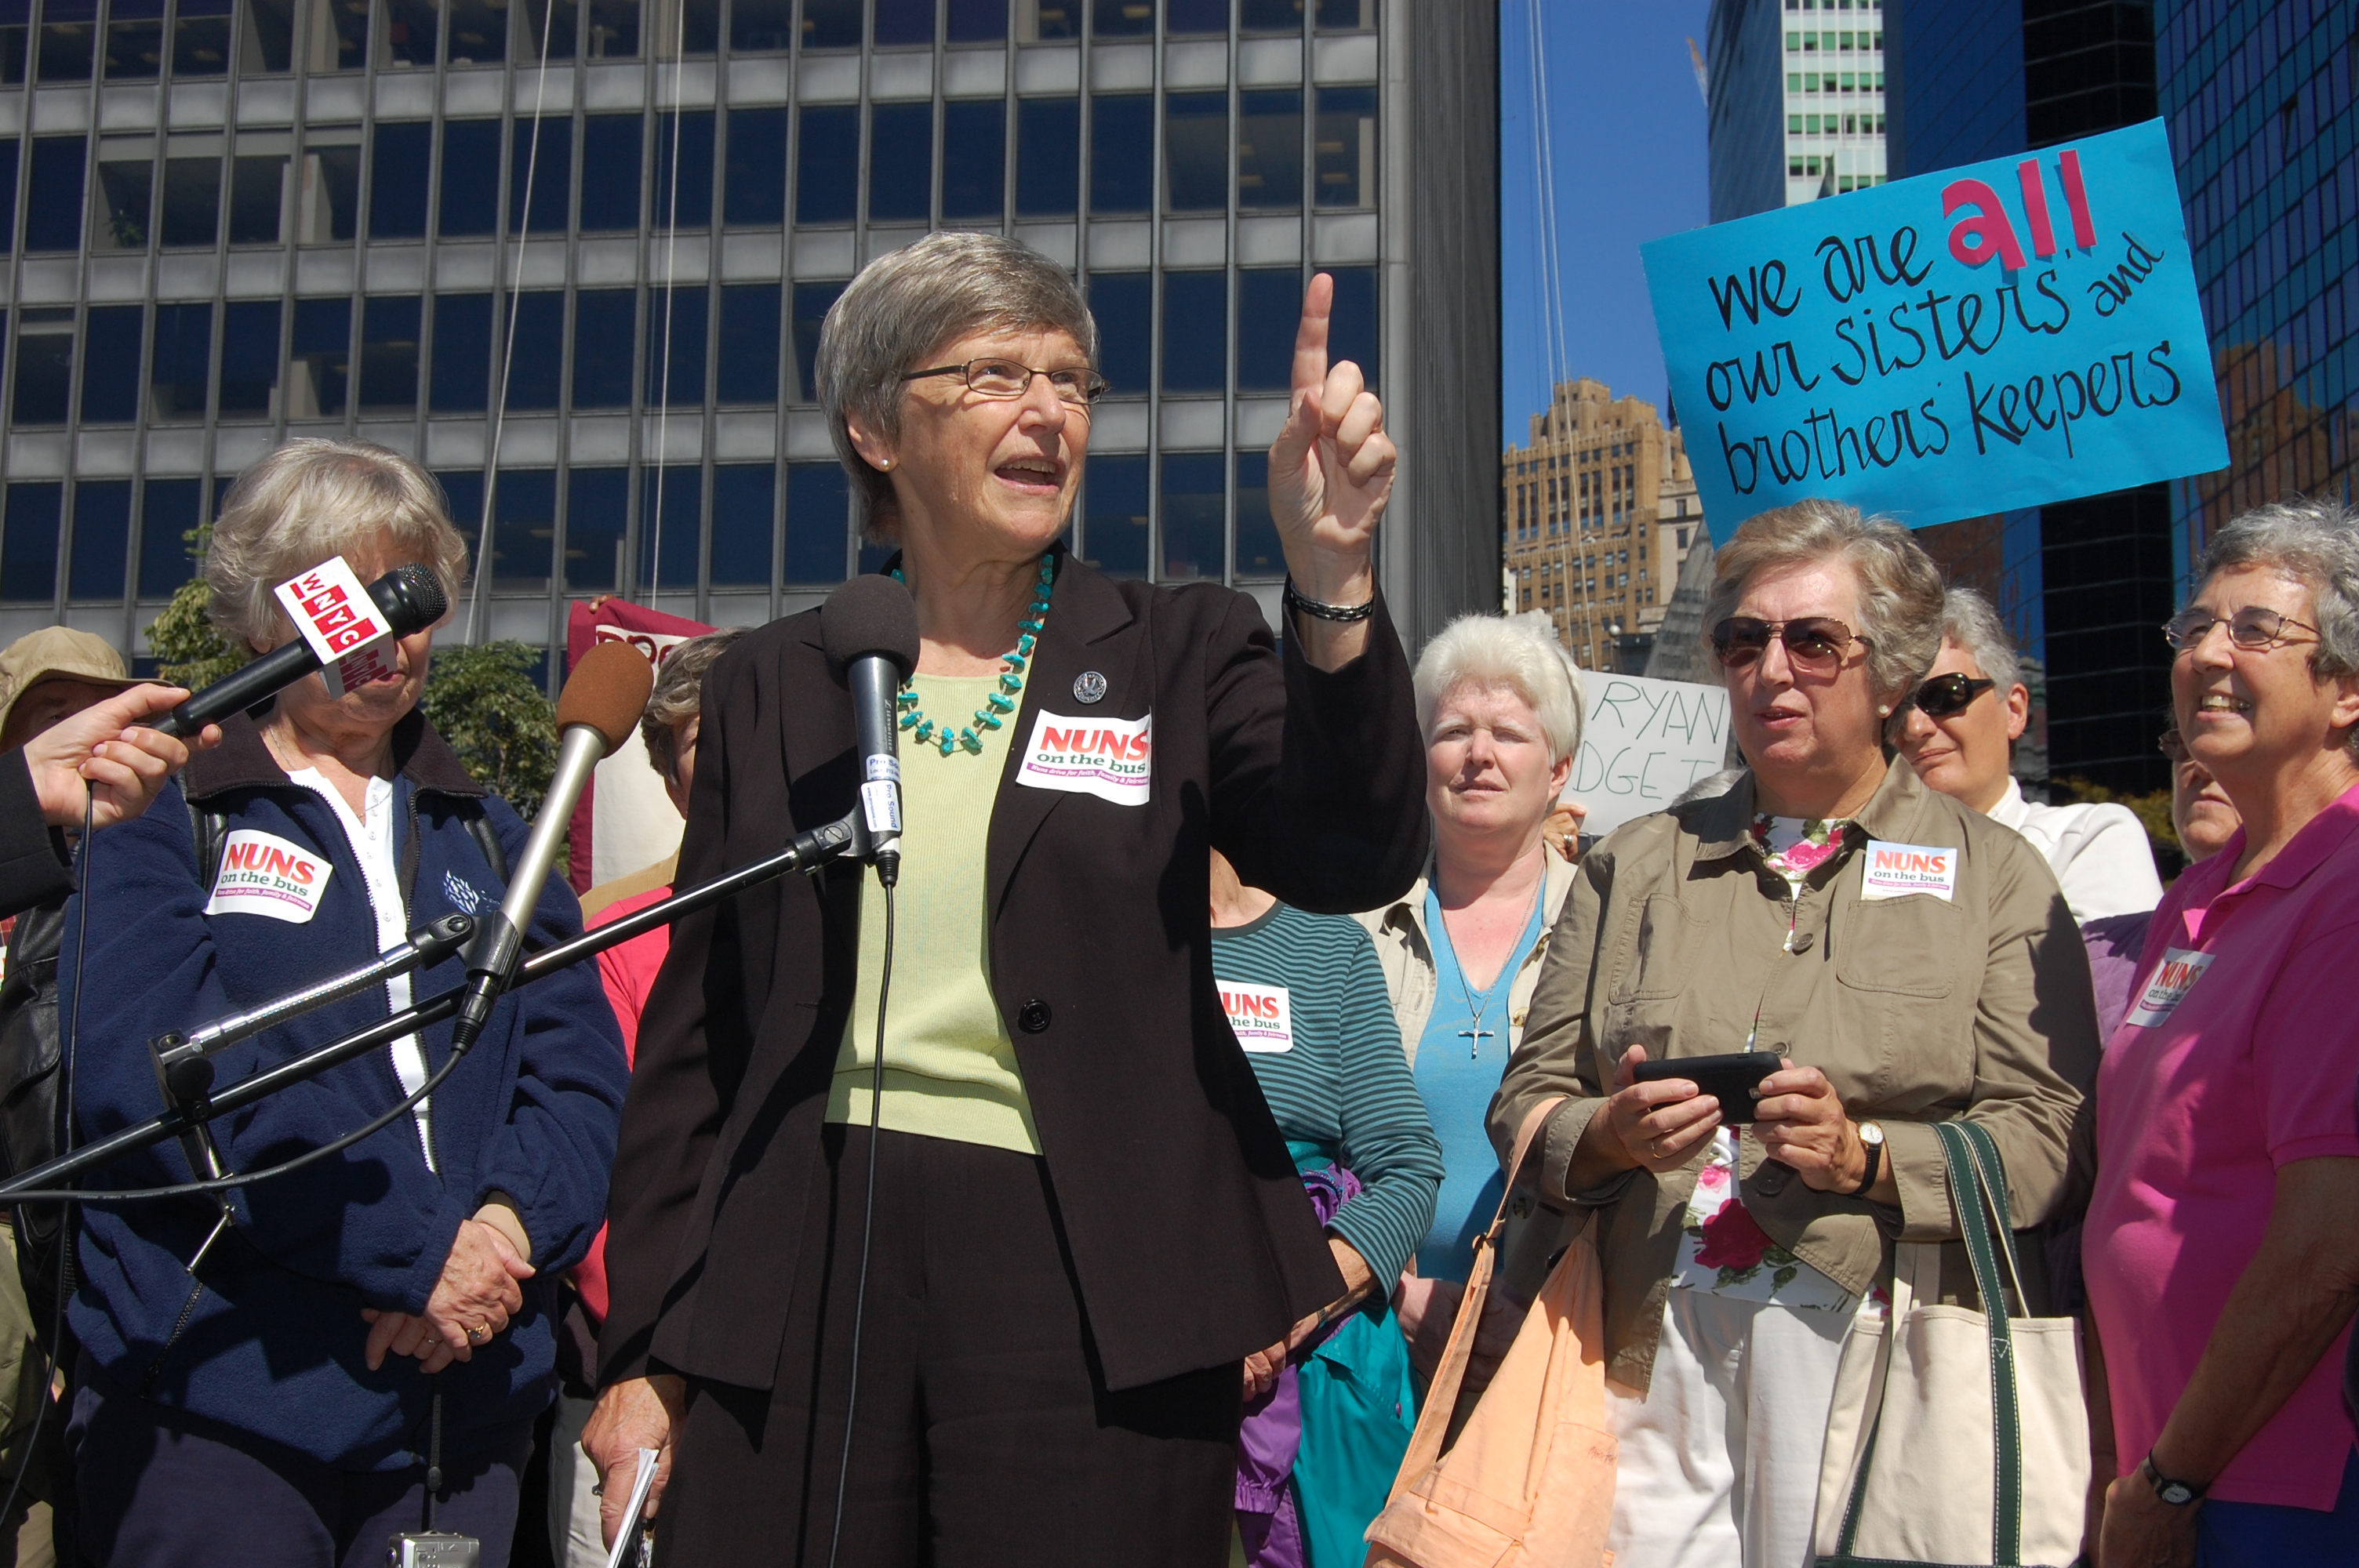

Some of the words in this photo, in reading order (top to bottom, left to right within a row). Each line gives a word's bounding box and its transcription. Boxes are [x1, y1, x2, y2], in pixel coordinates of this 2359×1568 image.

[1708, 259, 1801, 332] we
[1814, 225, 1935, 304] are
[1941, 148, 2097, 274] all
[1706, 340, 1820, 412] our
[2086, 230, 2165, 318] and
[1964, 339, 2182, 459] keepers
[301, 572, 362, 646] WNYC
[350, 646, 373, 687] WNYC
[1590, 681, 1725, 746] RYAN
[1040, 725, 1150, 761] NUNS
[1036, 753, 1064, 764] on
[1070, 753, 1105, 767] the
[1108, 758, 1147, 775] bus
[887, 800, 899, 829] Sound
[224, 842, 316, 885] NUNS
[1874, 850, 1946, 874] NUNS
[1874, 870, 1891, 879] on
[1895, 871, 1917, 882] the
[1920, 873, 1944, 883] bus
[220, 872, 237, 884] on
[241, 871, 270, 885] the
[272, 876, 309, 897] bus
[2154, 960, 2204, 991] NUNS
[1218, 992, 1280, 1019] UNS
[2148, 989, 2159, 999] on
[2158, 989, 2172, 1001] the
[1229, 1016, 1250, 1027] he
[1253, 1018, 1281, 1029] bus
